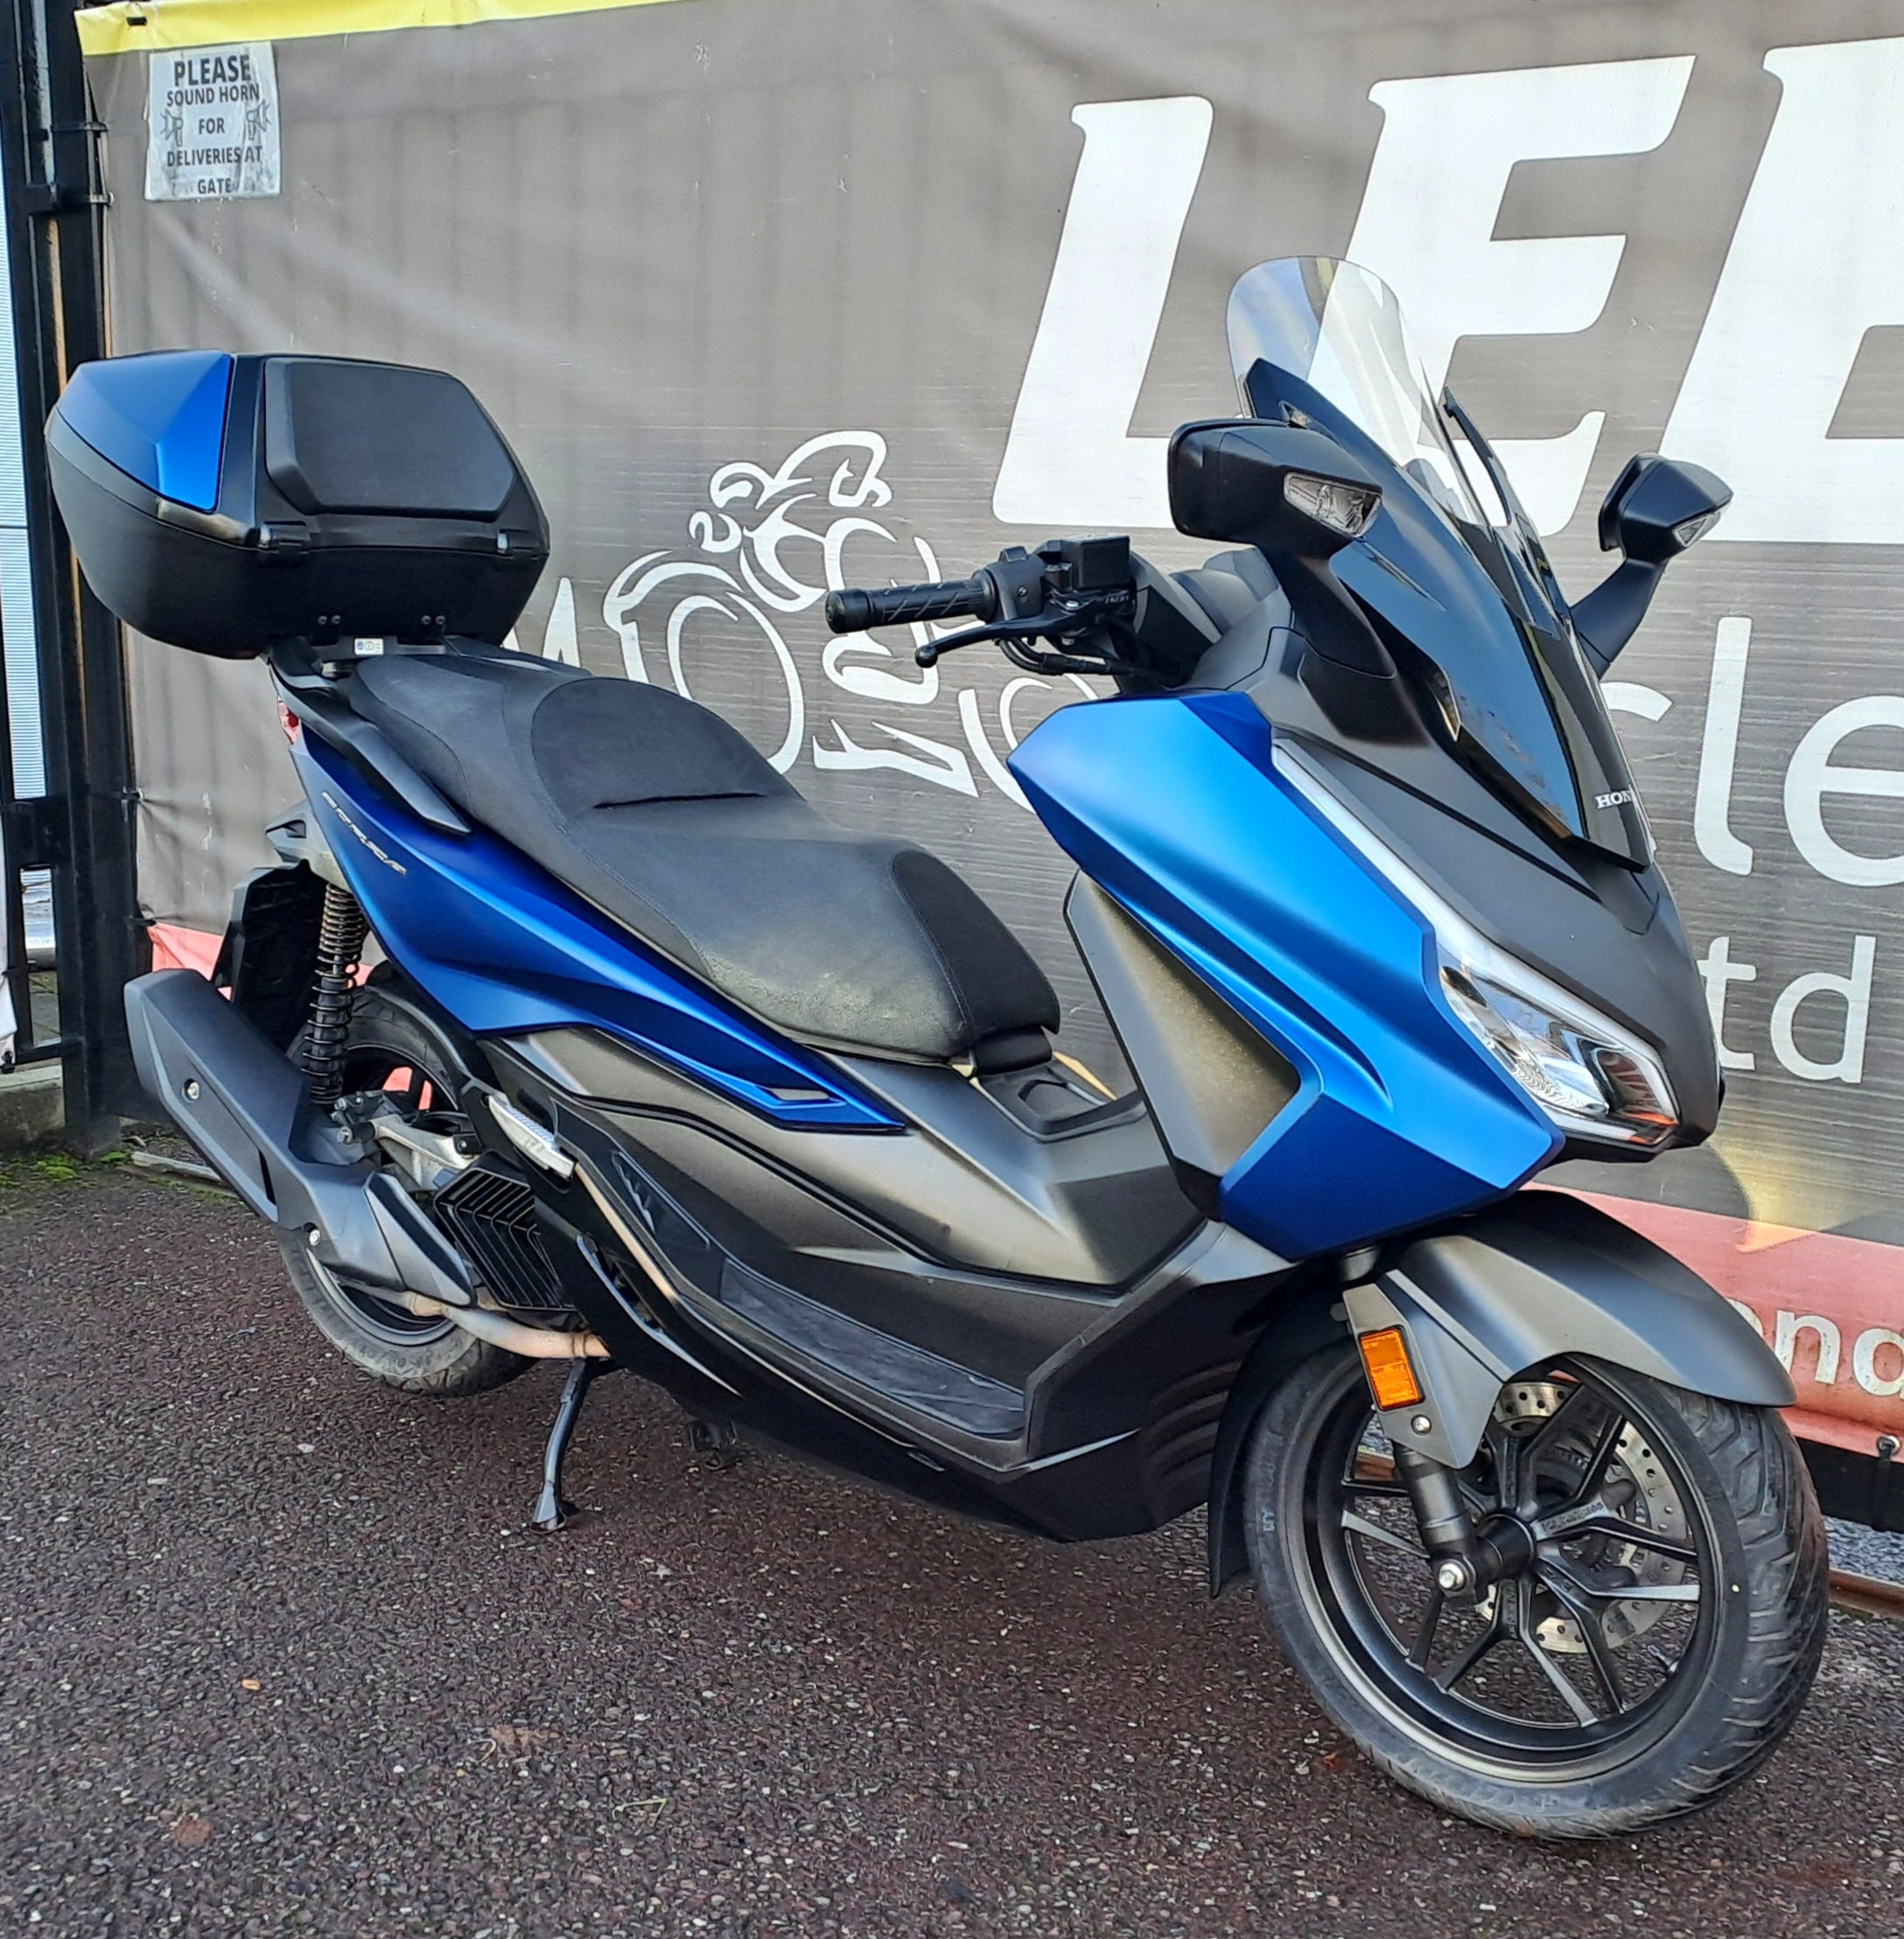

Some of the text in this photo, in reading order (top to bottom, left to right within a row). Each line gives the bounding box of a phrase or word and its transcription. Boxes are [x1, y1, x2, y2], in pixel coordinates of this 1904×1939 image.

[174, 54, 251, 87] PLEASE
[166, 83, 260, 107] SOUND HORN
[198, 117, 225, 135] FOR
[166, 145, 262, 167] DELIVERIES AT
[198, 178, 232, 194] GATE
